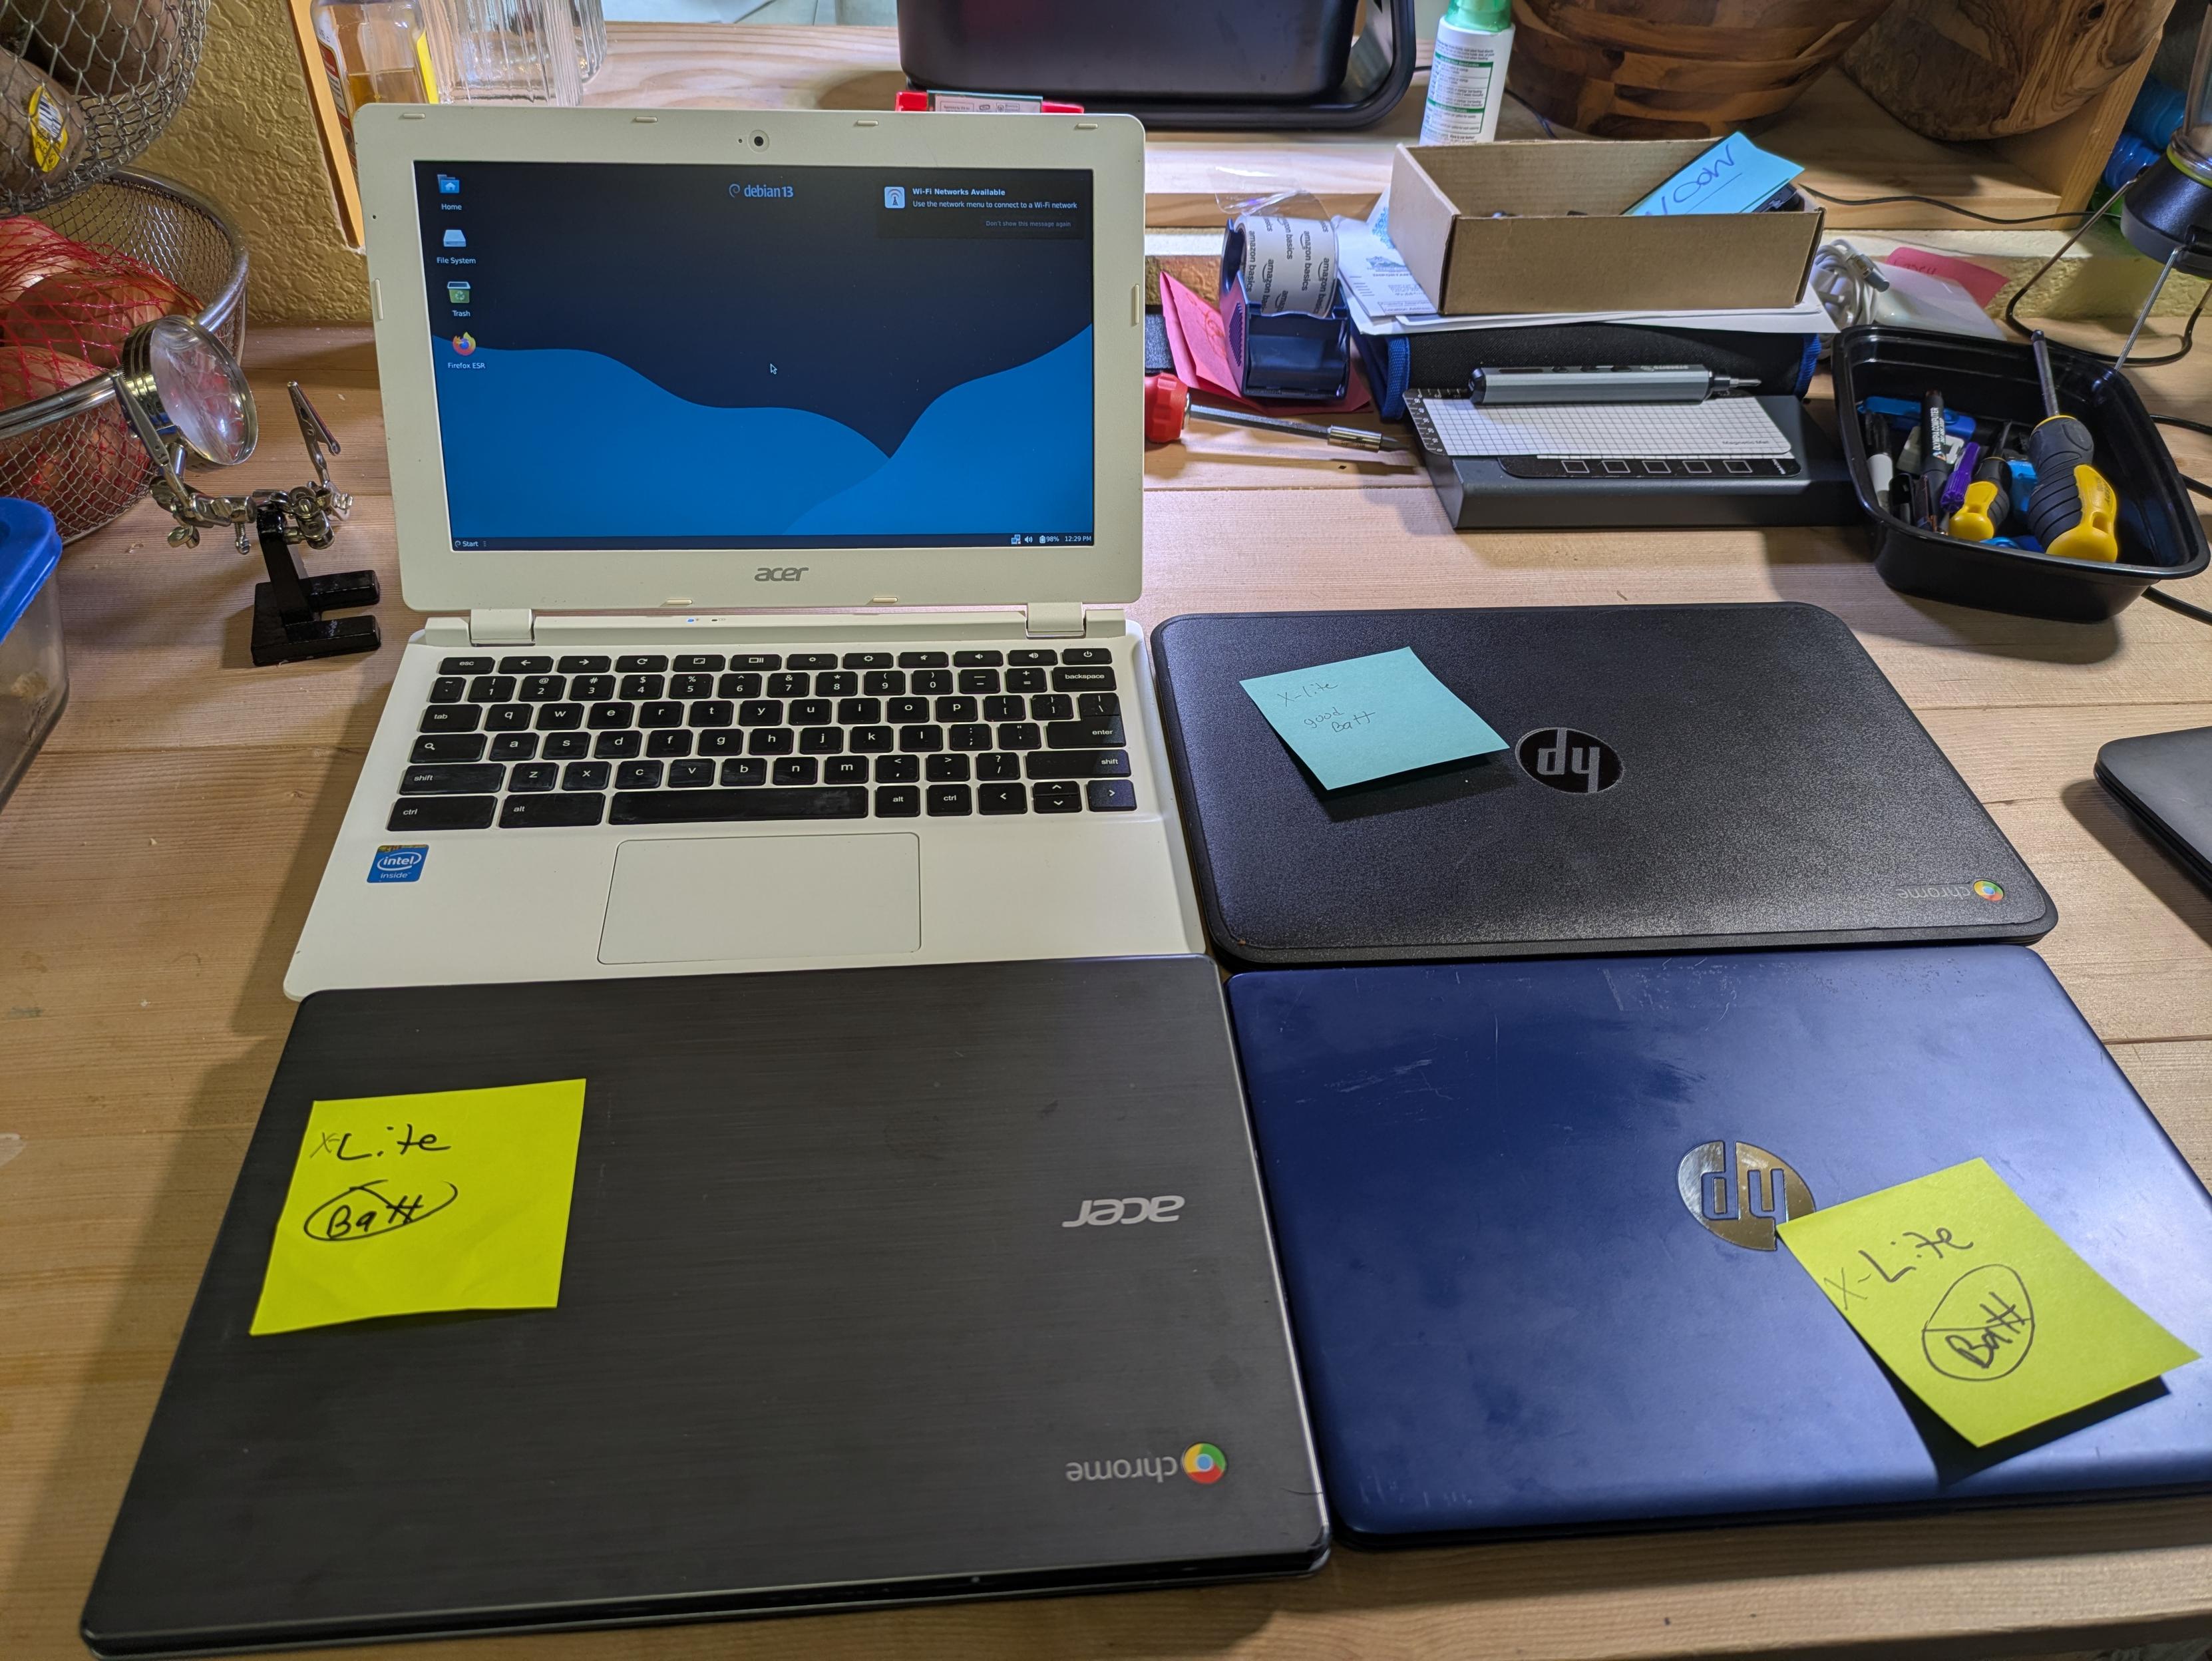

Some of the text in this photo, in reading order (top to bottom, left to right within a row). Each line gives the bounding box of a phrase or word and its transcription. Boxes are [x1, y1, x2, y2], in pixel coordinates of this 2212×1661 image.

[1302, 230, 1312, 291] amazon basics
[1246, 264, 1257, 293] basics
[1264, 259, 1274, 294] amazon
[1320, 257, 1330, 293] amazon
[754, 567, 809, 582] acer
[1304, 706, 1345, 729] good
[820, 733, 825, 743] j
[383, 856, 415, 865] intel
[1895, 886, 1970, 900] chrome
[1061, 1195, 1185, 1227] acer
[1065, 1456, 1178, 1483] chrome
